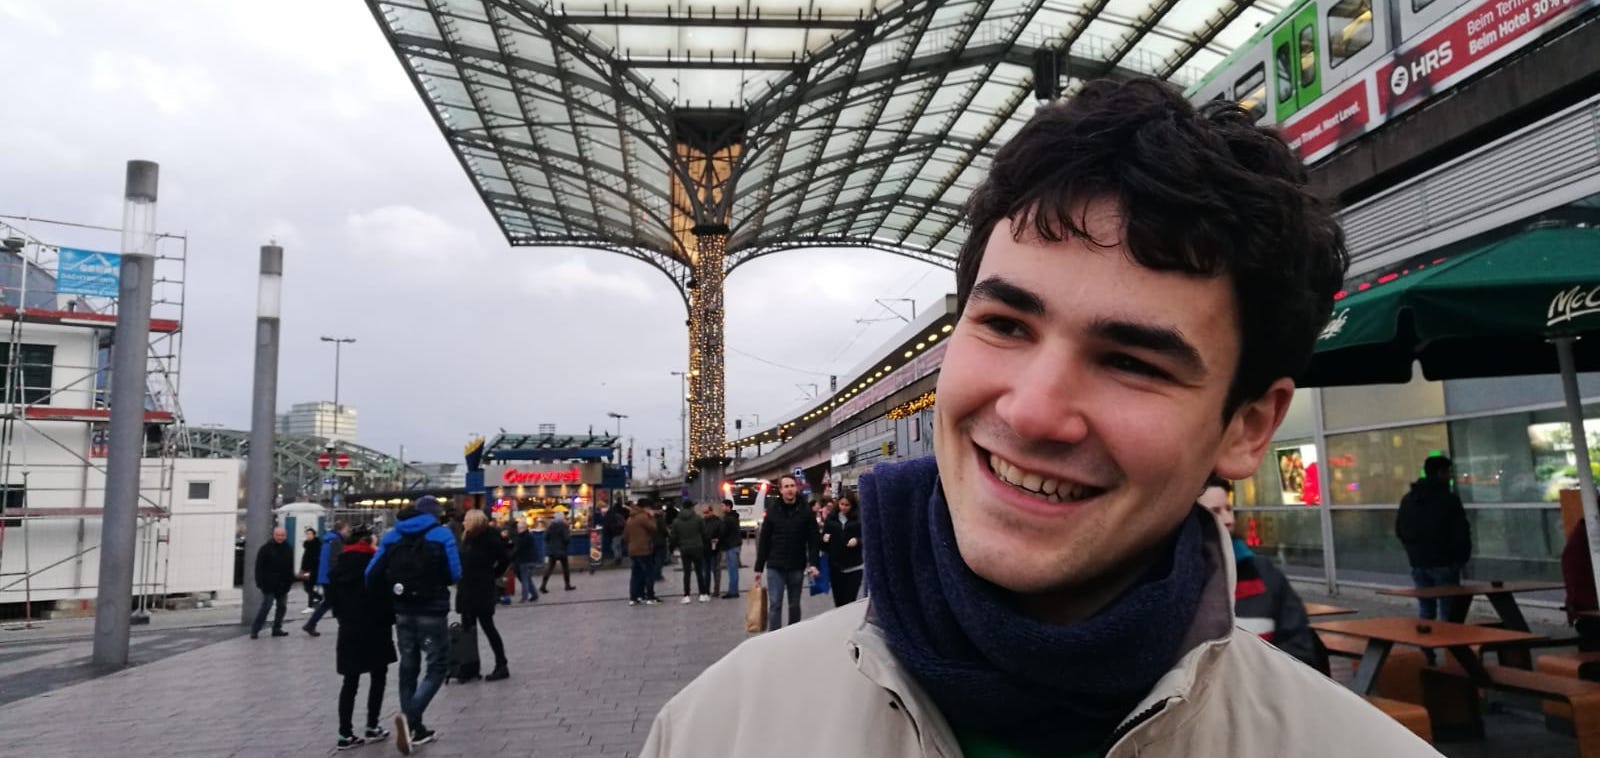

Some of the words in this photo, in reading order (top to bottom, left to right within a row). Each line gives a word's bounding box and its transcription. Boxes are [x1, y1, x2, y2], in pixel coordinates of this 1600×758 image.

[1467, 11, 1494, 35] Beim
[1468, 29, 1497, 55] Beim
[1498, 7, 1530, 38] Hotel
[1411, 41, 1453, 82] HRS
